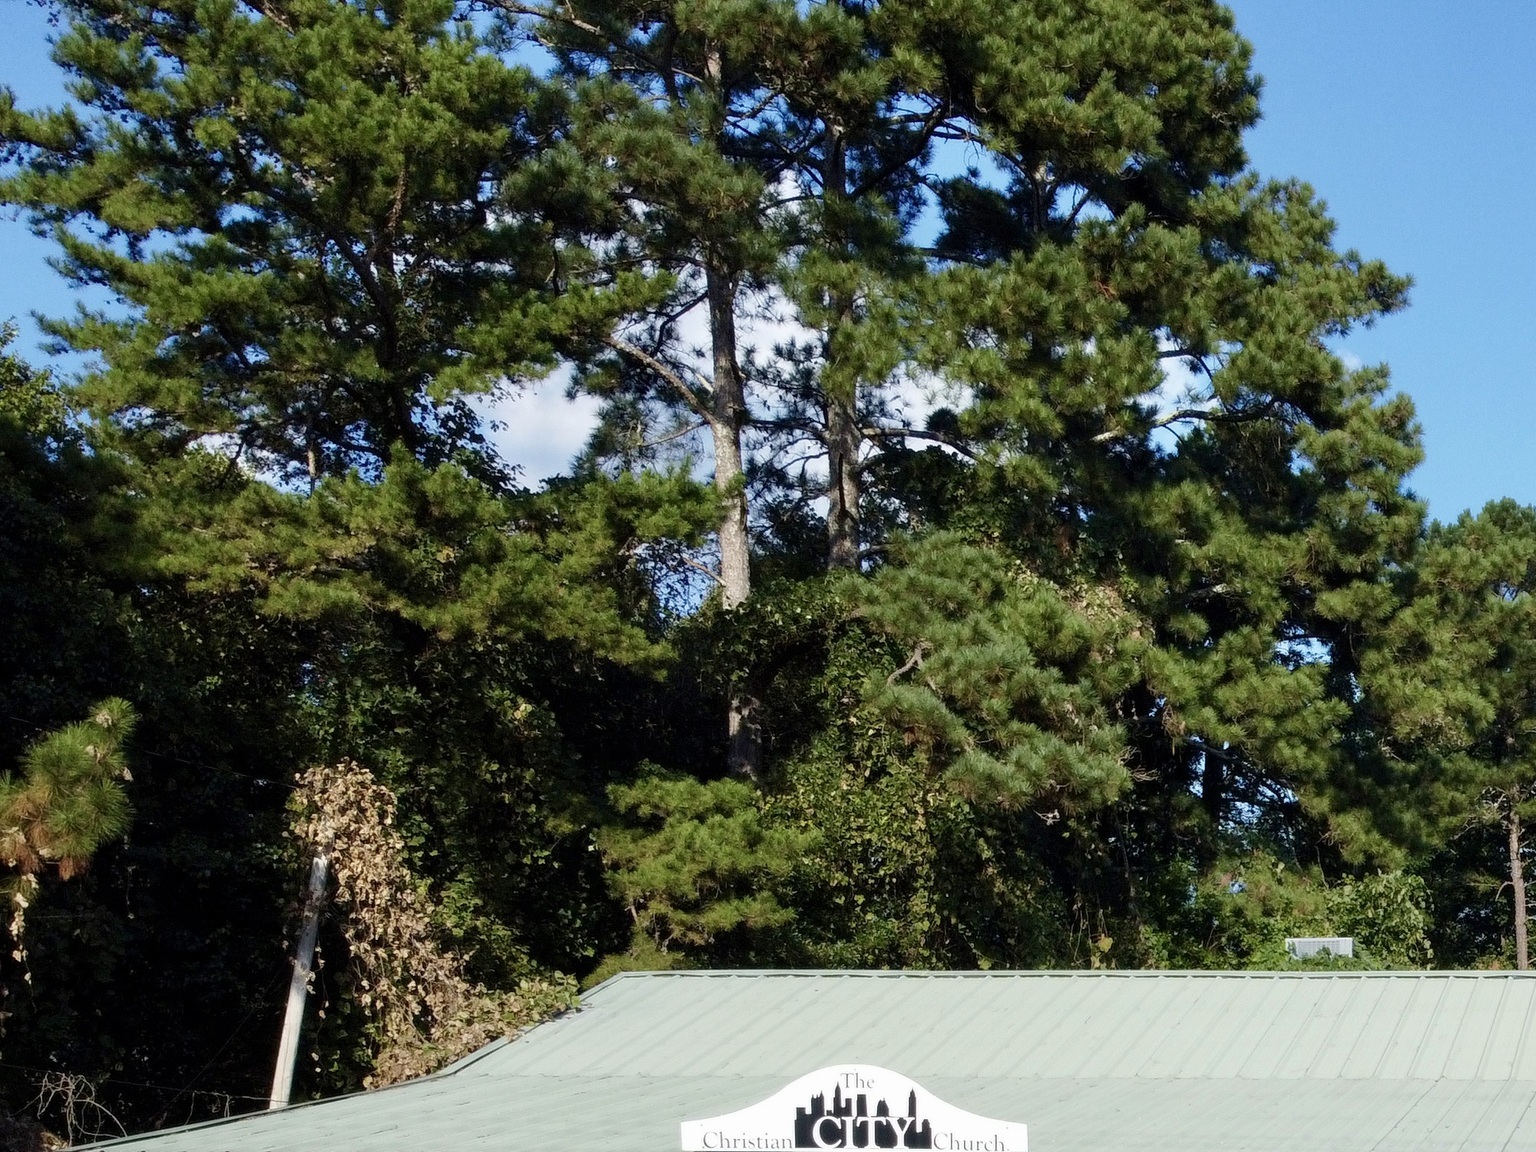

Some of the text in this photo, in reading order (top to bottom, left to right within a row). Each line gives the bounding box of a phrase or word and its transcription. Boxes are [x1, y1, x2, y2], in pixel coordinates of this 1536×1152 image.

[840, 1072, 875, 1089] The
[703, 1115, 1005, 1152] Christian CITY Church
